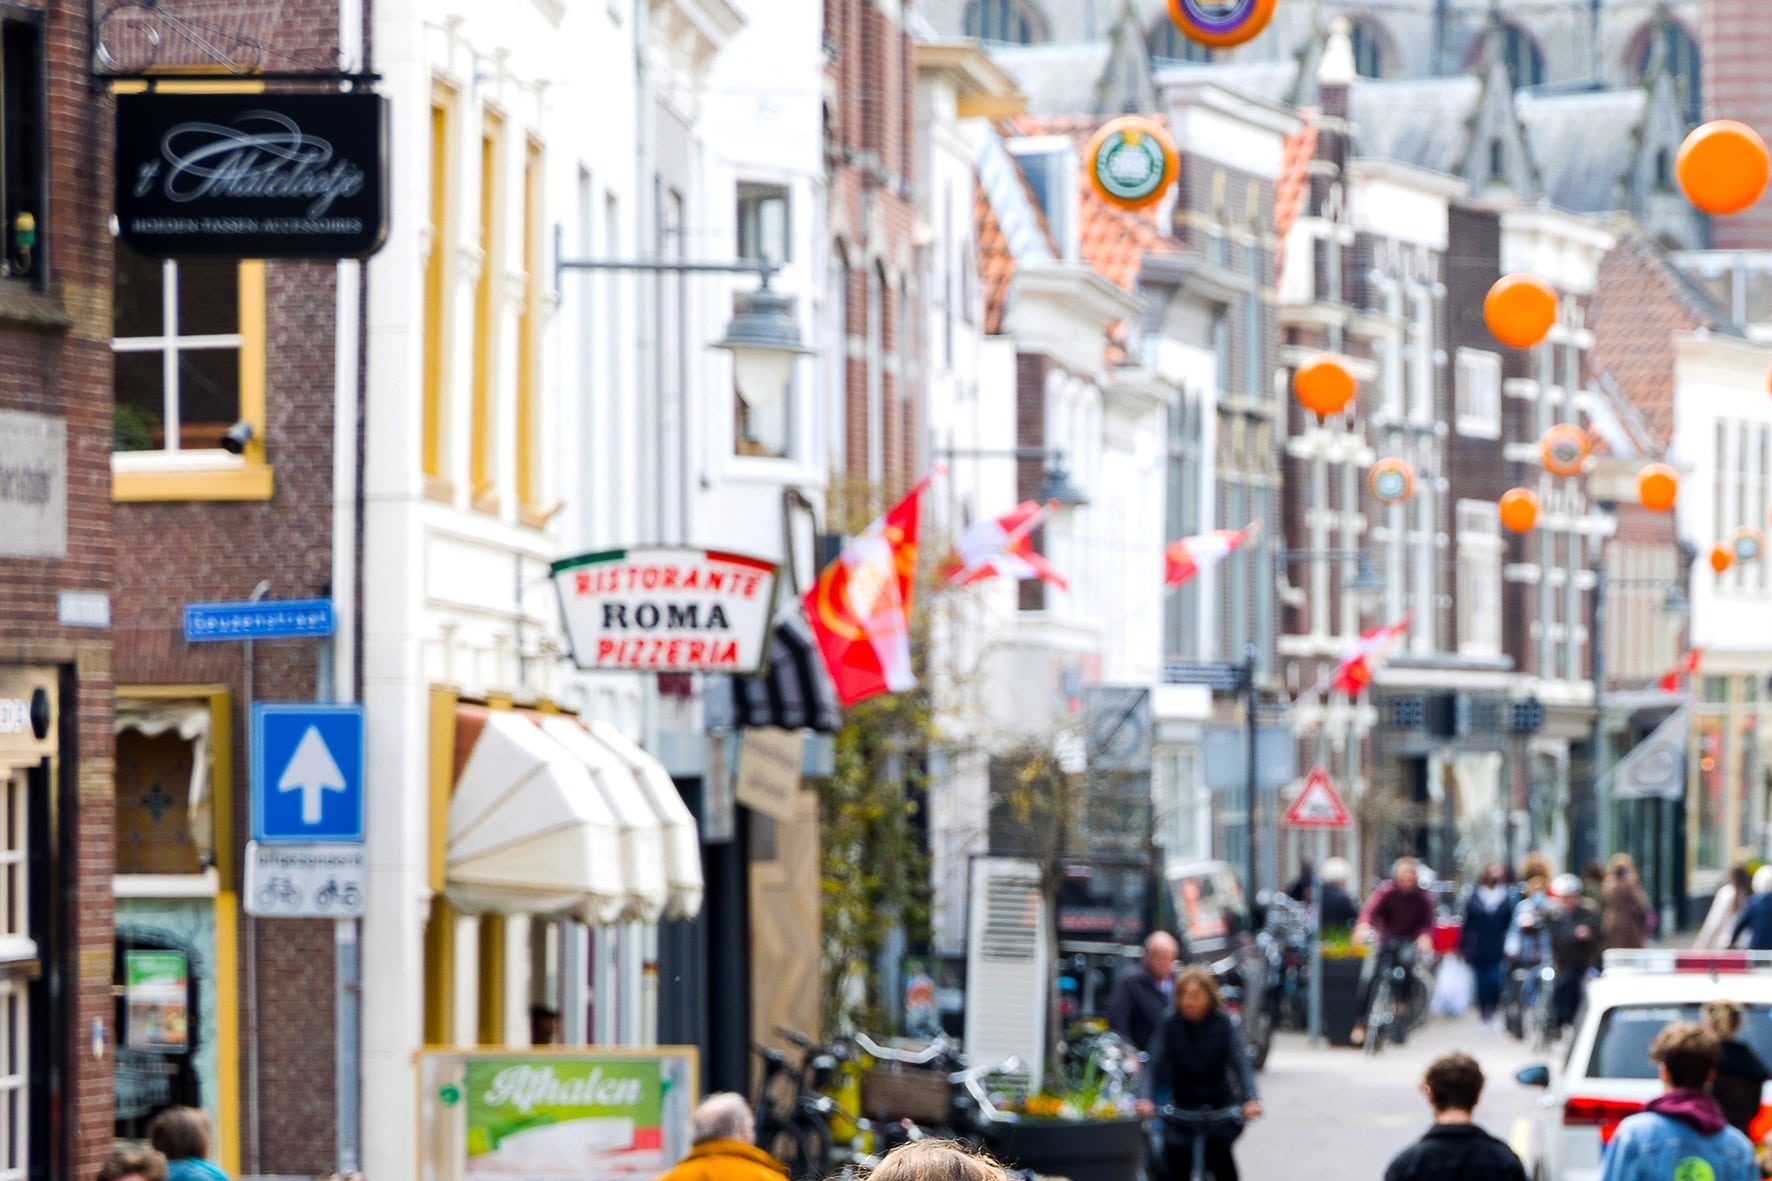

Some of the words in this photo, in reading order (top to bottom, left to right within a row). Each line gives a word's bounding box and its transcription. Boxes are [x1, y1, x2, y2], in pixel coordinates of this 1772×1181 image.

[575, 566, 761, 599] RISTORANTE
[602, 603, 730, 629] ROMA
[597, 639, 738, 665] PIZZERIA
[484, 1064, 642, 1113] Afhalen
